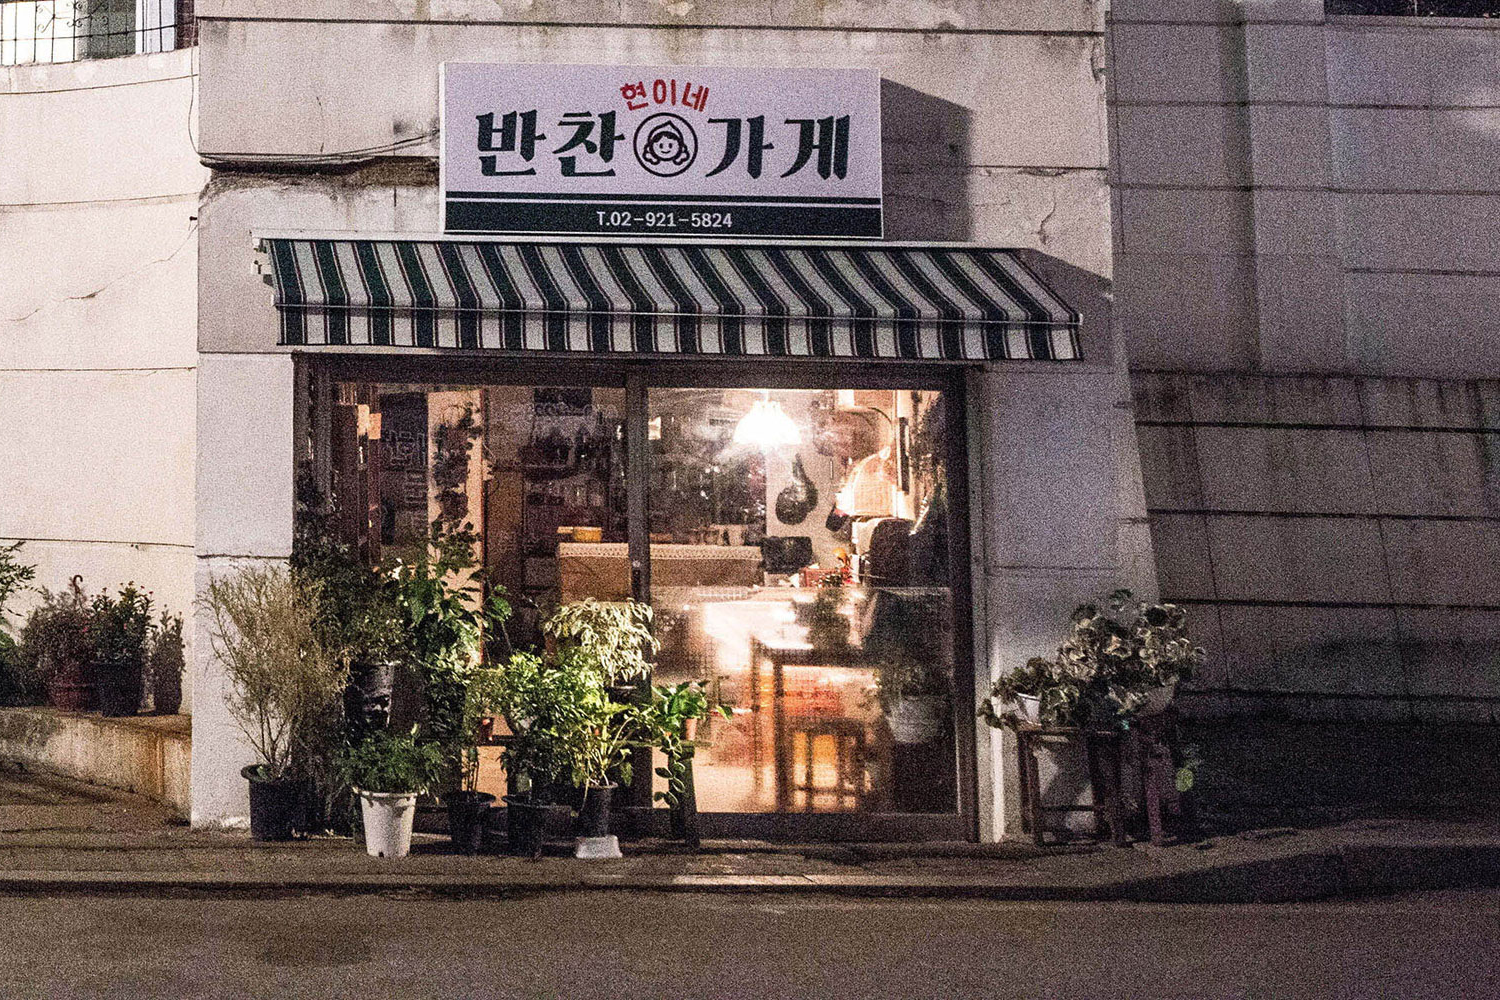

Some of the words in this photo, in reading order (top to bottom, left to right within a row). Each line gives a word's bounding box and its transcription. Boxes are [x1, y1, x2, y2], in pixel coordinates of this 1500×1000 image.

[619, 78, 711, 113] 현이네
[475, 109, 626, 178] 반찬
[703, 113, 851, 181] 가게
[595, 210, 734, 229] T.02-921-5824
